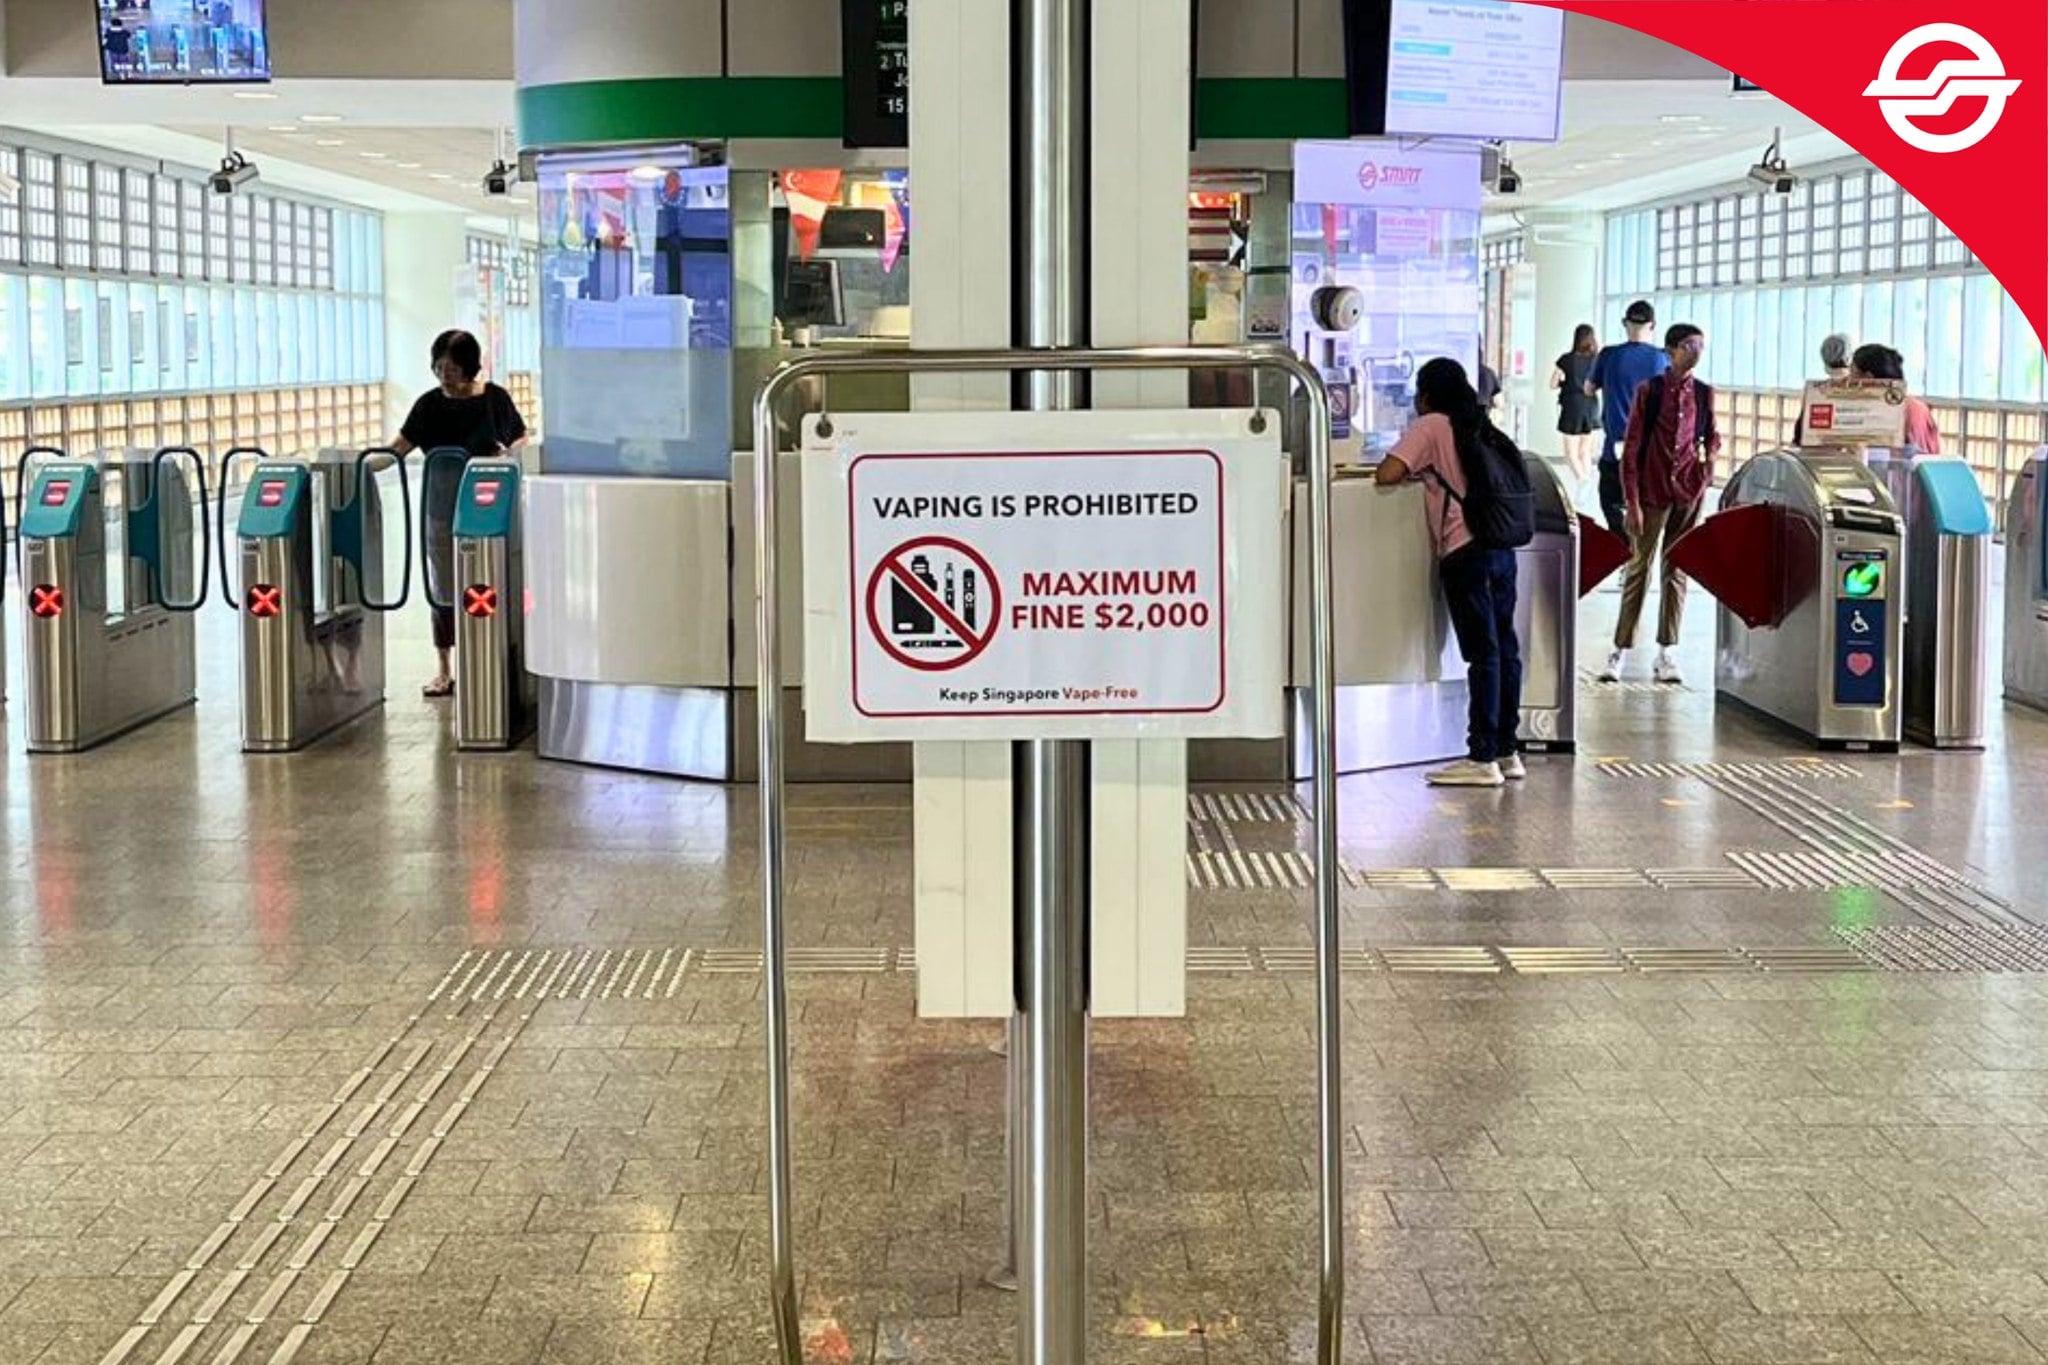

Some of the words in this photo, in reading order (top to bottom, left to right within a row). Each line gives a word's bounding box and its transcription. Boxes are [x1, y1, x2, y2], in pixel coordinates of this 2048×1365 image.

[880, 55, 888, 70] 2
[887, 98, 904, 113] 15
[873, 496, 982, 518] VAPING
[992, 495, 1016, 517] IS
[1025, 493, 1198, 516] PROHIBITED
[1023, 570, 1196, 596] MAXIMUM
[1012, 605, 1085, 629] FINE
[1095, 602, 1209, 631] $2,000
[939, 687, 979, 703] Keep
[982, 687, 1059, 703] Singapore
[1062, 685, 1138, 701] Vape-Free
